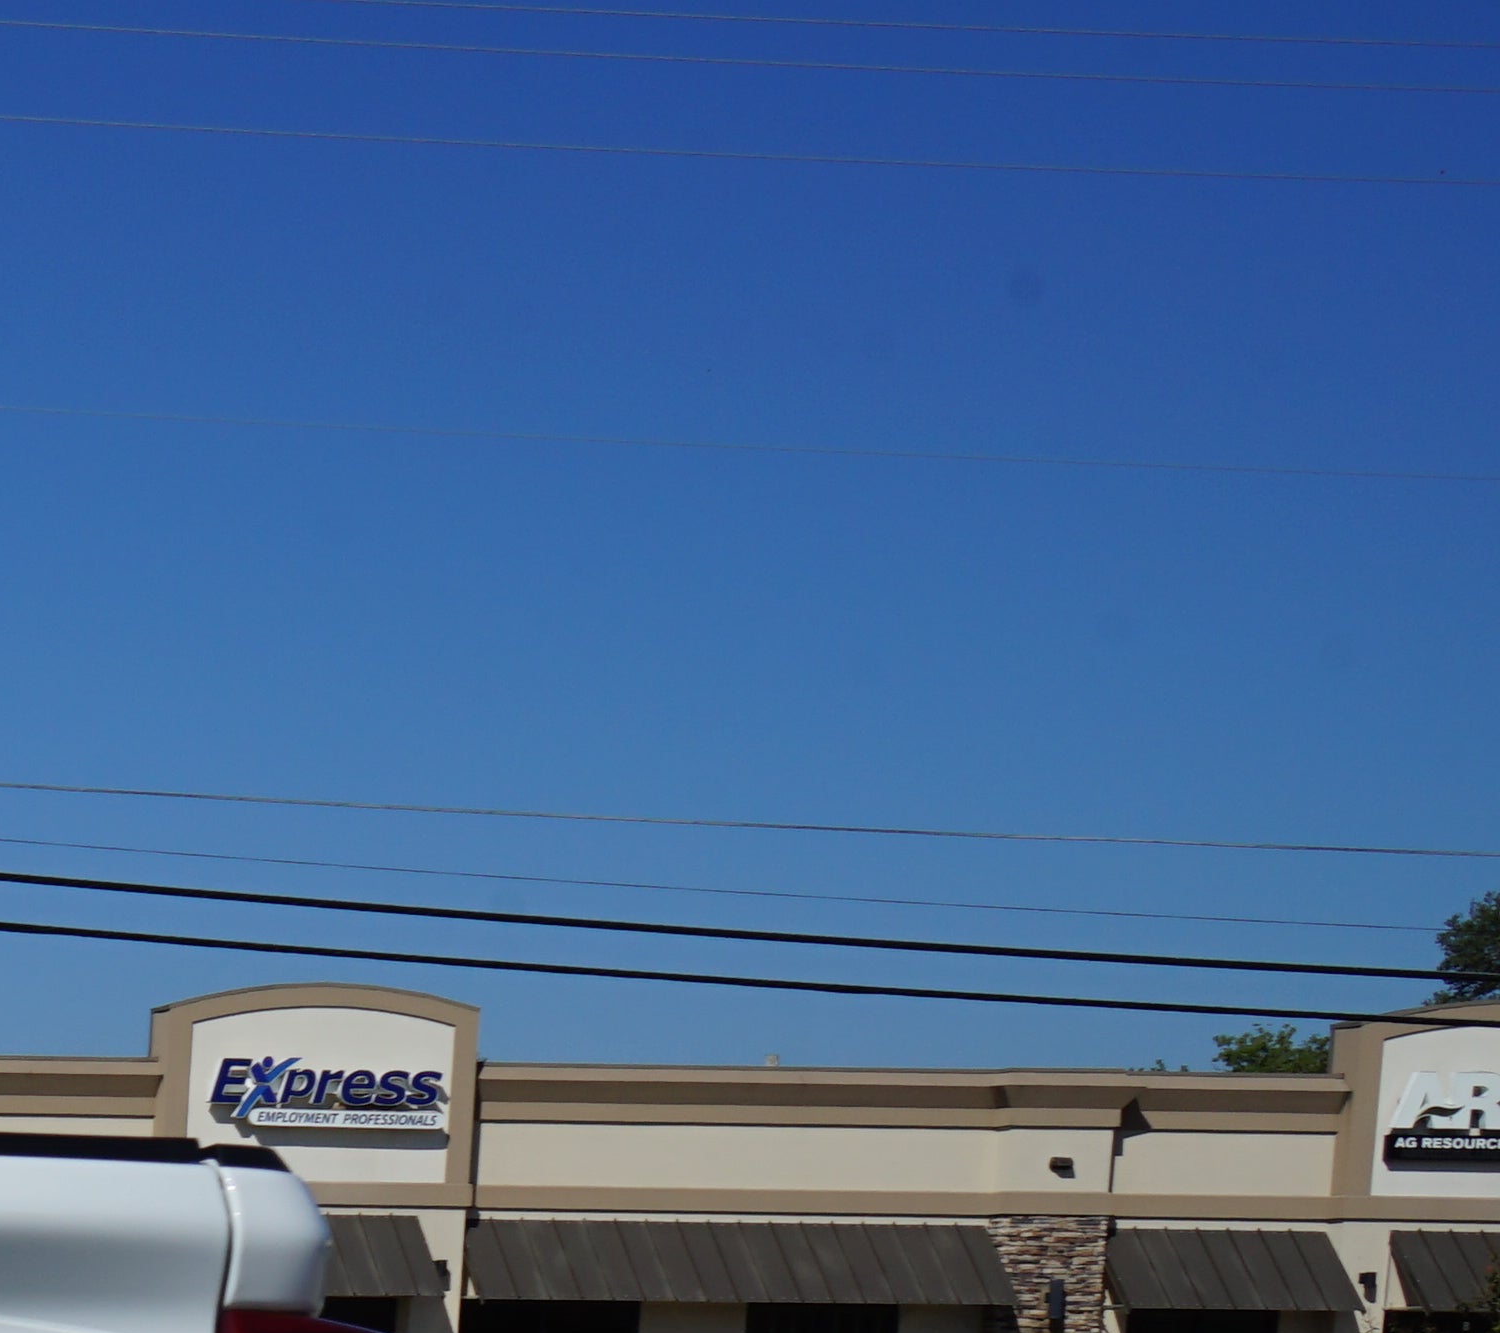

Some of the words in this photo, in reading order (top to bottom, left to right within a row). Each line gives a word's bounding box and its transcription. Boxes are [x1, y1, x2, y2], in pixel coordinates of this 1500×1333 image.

[257, 1111, 339, 1124] EMPLOYMENT
[343, 1113, 438, 1126] PROFESSIONALS
[1394, 1137, 1418, 1148] AG
